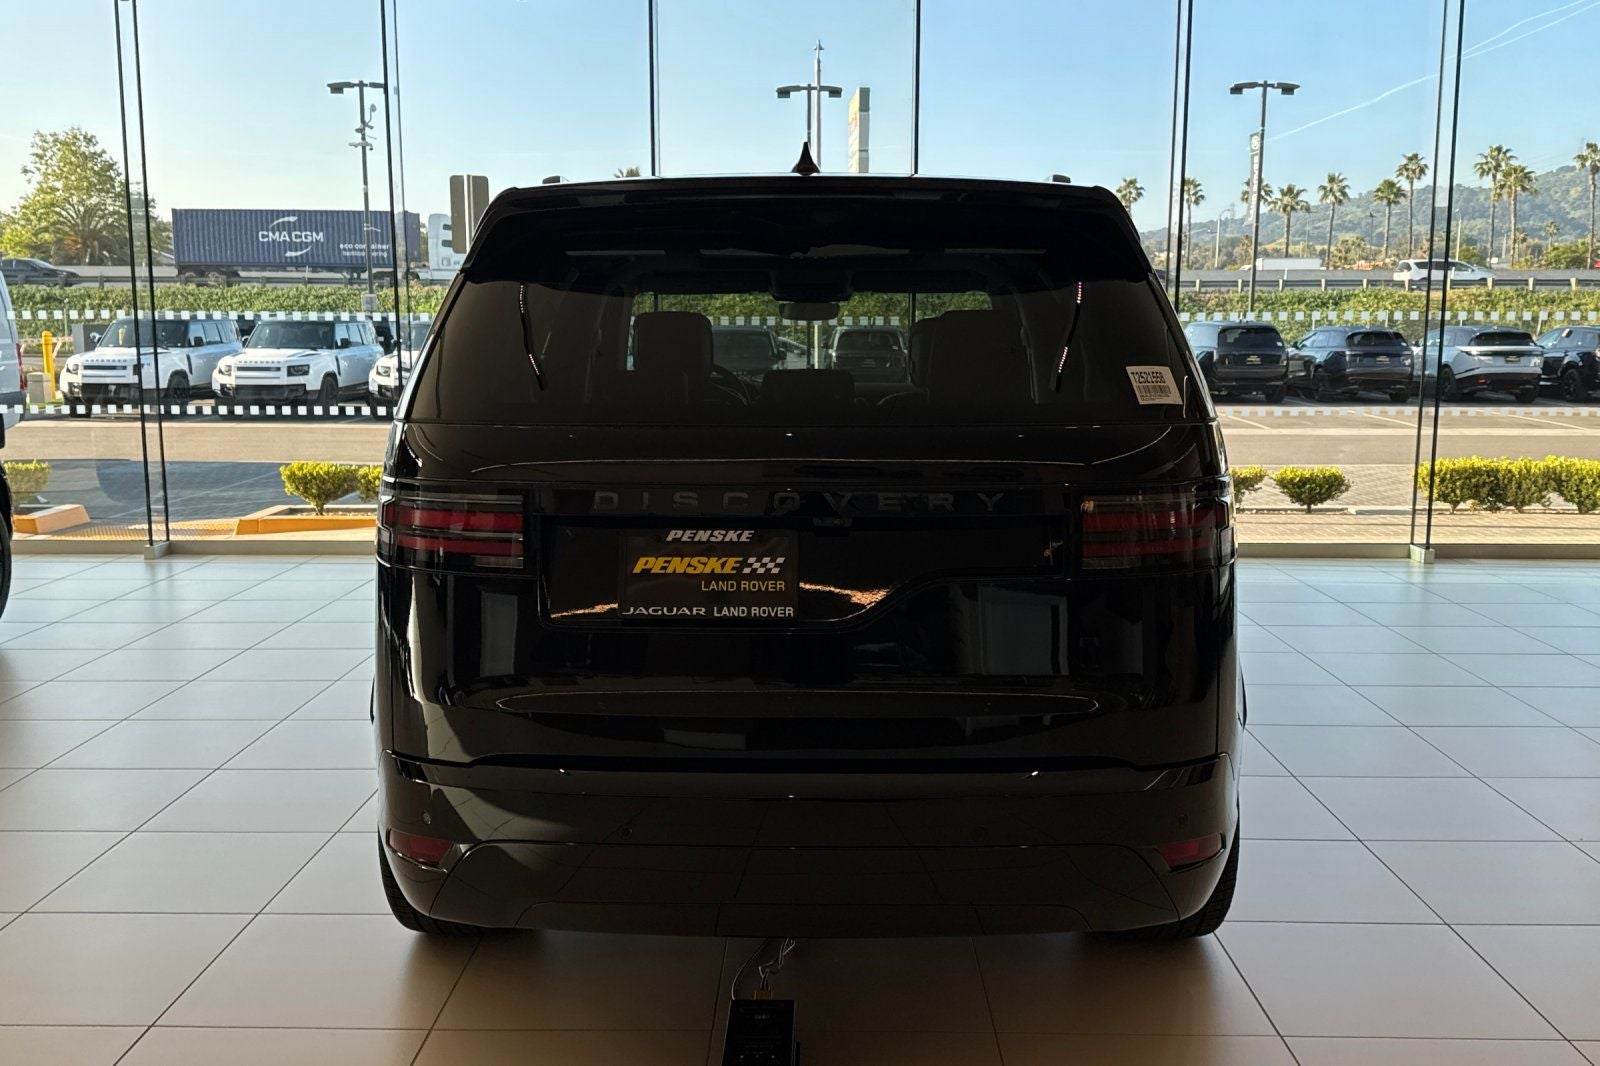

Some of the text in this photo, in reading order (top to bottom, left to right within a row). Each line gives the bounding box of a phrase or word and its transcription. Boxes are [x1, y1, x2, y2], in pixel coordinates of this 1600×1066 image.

[258, 231, 324, 242] CMA CGM
[592, 491, 1006, 511] DISCOVERY
[665, 529, 755, 542] PENSKE
[632, 556, 744, 574] PENSKE
[701, 580, 785, 592] LAND ROVER
[622, 606, 794, 617] JAGUAR LAND ROVER
